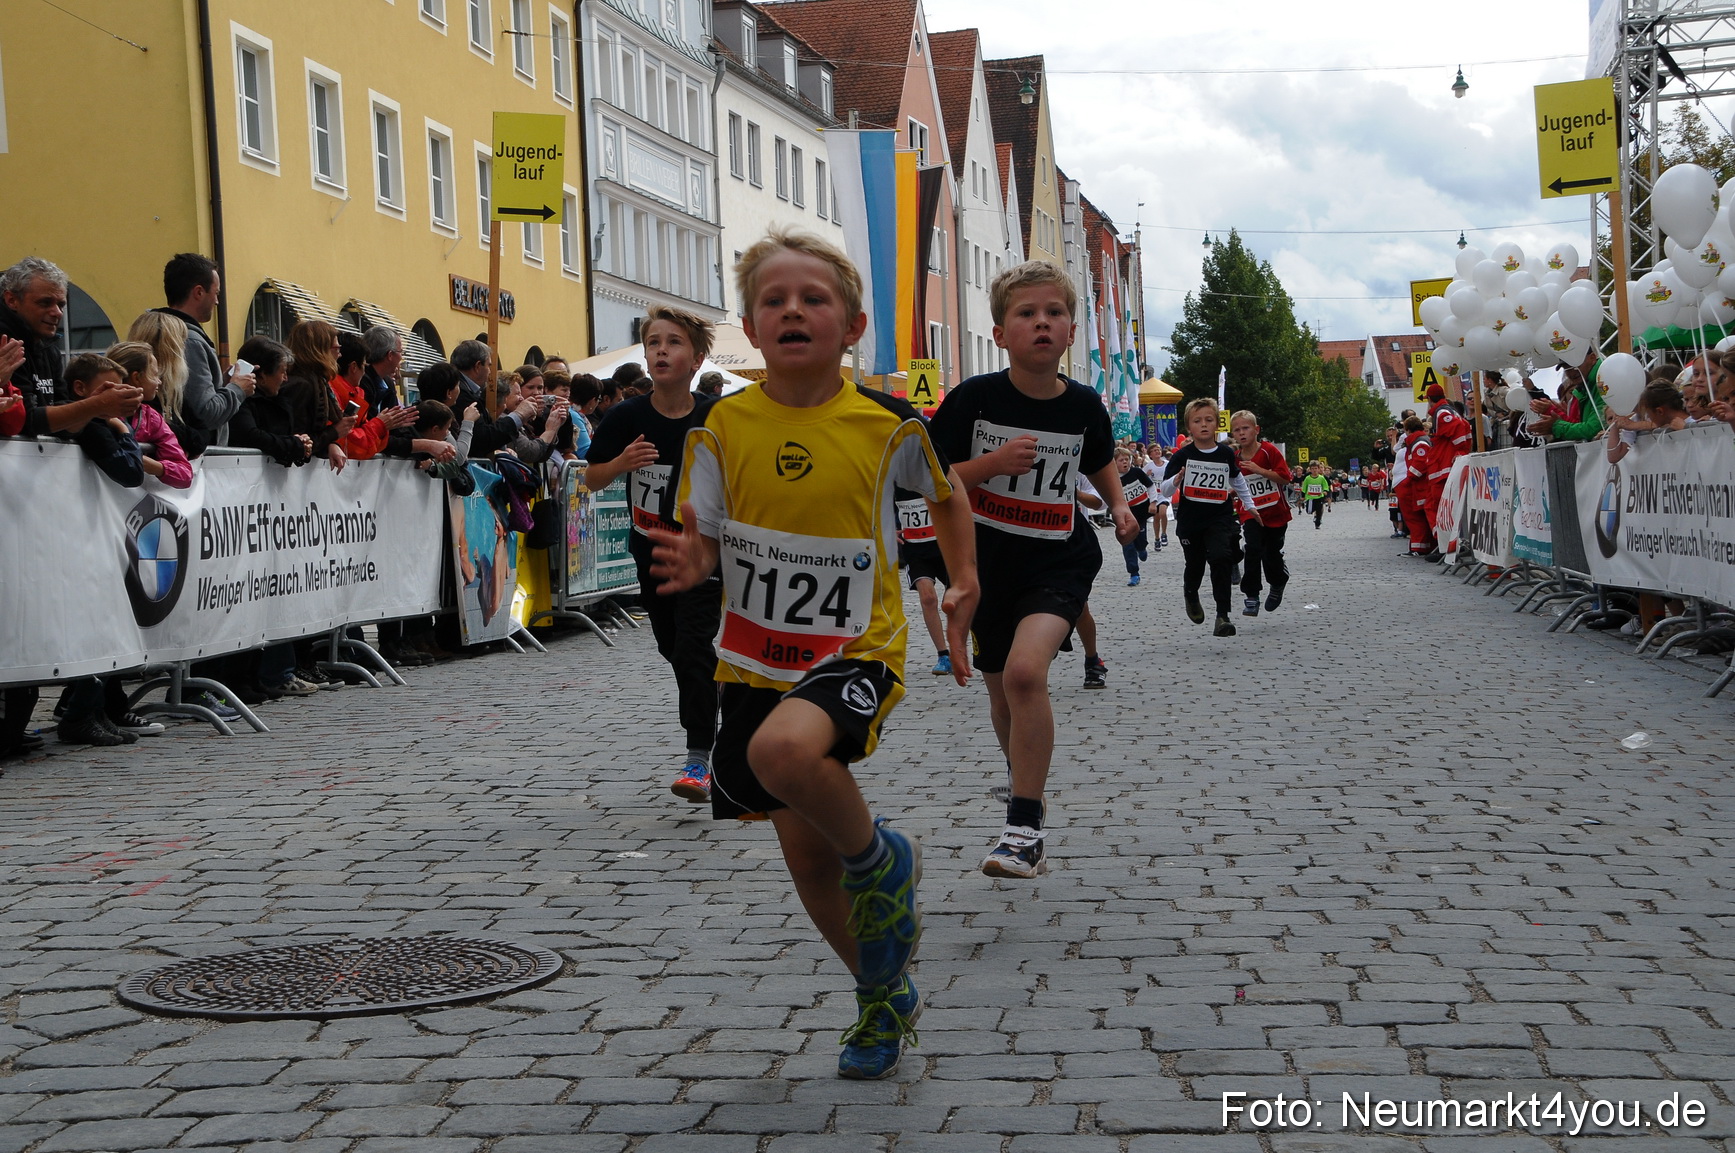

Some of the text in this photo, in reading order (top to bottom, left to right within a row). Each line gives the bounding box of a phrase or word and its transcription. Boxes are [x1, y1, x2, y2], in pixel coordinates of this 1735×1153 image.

[1539, 108, 1612, 134] Jugend-
[496, 141, 562, 163] Jugend-
[1561, 132, 1594, 152] lauf
[513, 163, 545, 180] lauf
[910, 361, 936, 370] Block
[1416, 354, 1431, 364] Blo
[913, 374, 932, 397] A
[1421, 366, 1439, 391] A
[1034, 445, 1070, 456] markt
[636, 469, 656, 480] ARTL
[1190, 471, 1225, 489] 7229
[638, 480, 666, 513] 71
[1247, 479, 1273, 496] 094
[1626, 473, 1659, 514] BMW
[126, 499, 188, 538] BMW
[902, 510, 929, 527] 737
[977, 494, 1060, 526] Konstantin
[201, 501, 377, 560] BMW EfficientDynamics
[1626, 526, 1662, 559] Weniger
[723, 534, 847, 568] PARTL Neumarkt
[197, 574, 245, 614] Weniger
[305, 561, 329, 592] Mehr
[736, 558, 852, 628] 7124
[762, 637, 799, 664] Jan
